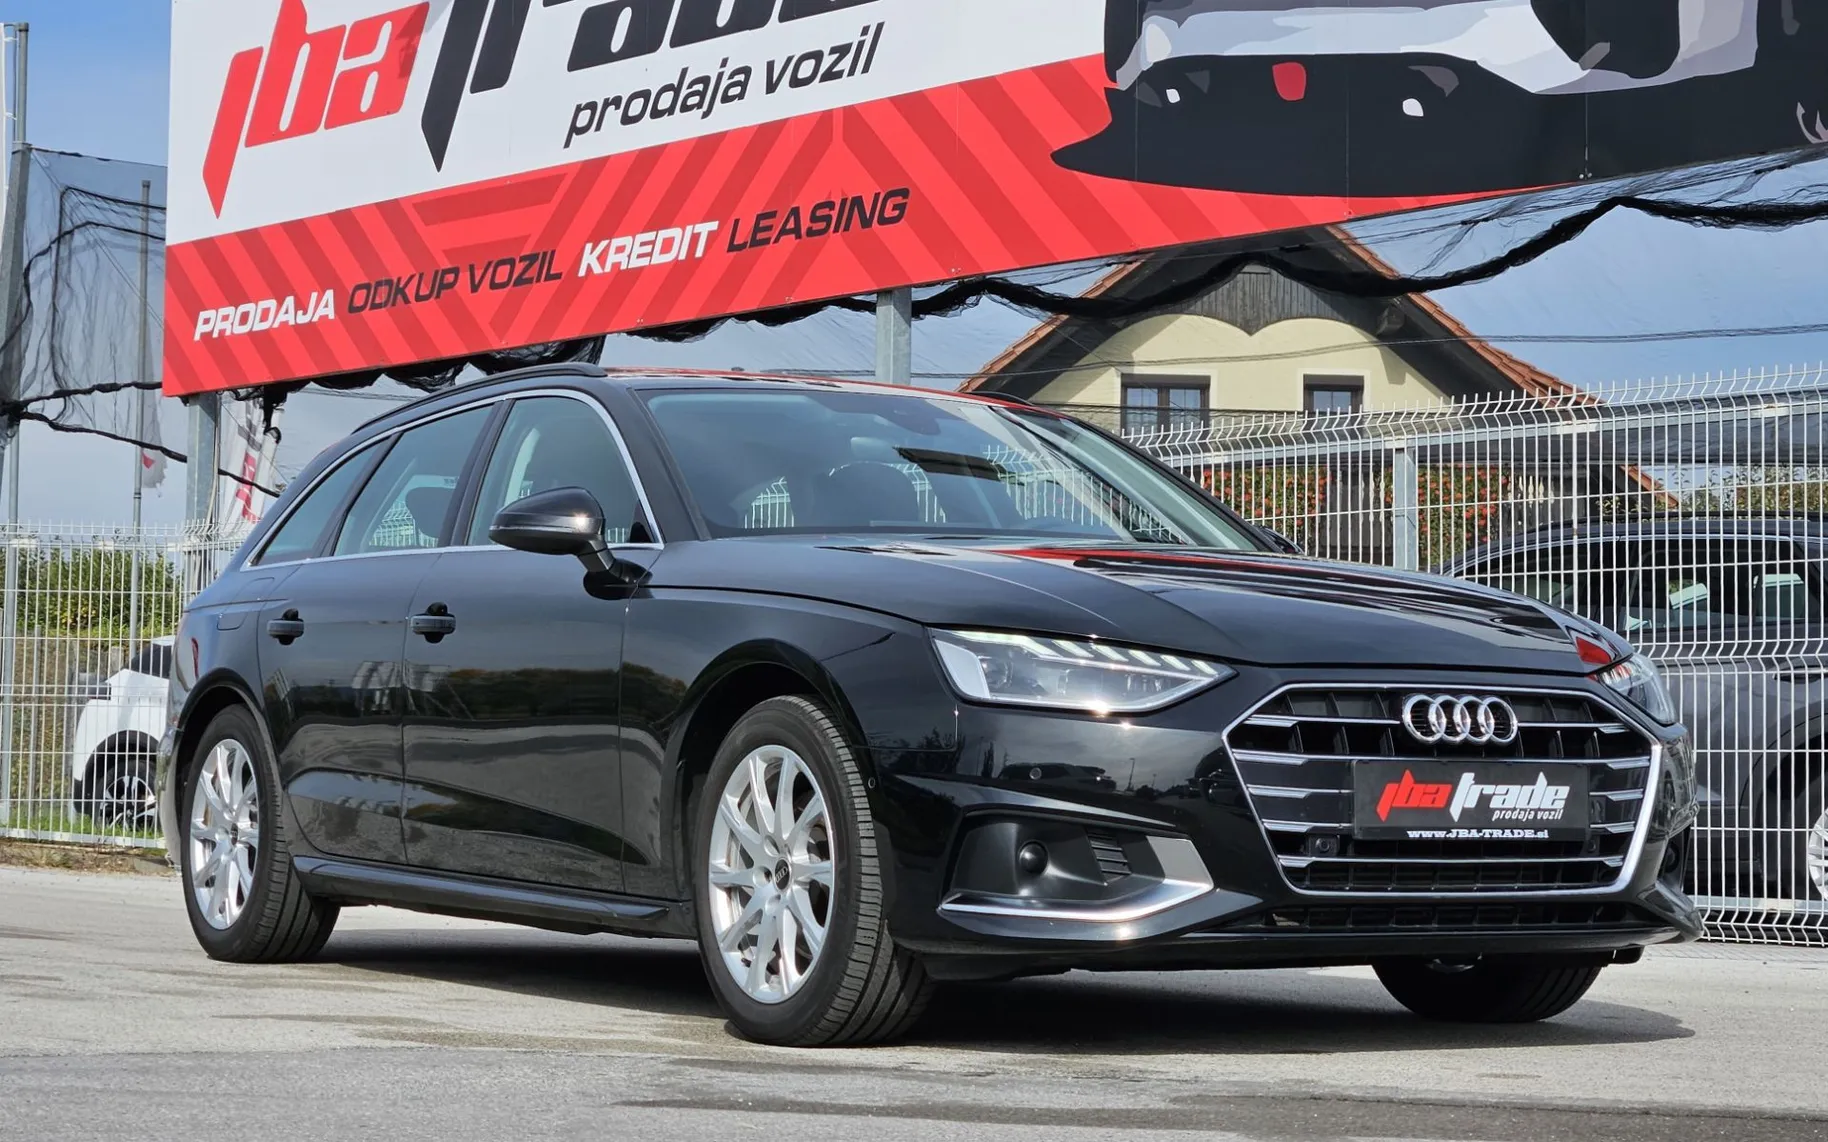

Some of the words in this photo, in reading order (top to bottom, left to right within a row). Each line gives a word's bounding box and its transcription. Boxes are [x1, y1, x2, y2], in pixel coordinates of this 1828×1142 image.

[563, 57, 752, 149] prodaja
[765, 21, 885, 95] vozil
[194, 289, 335, 341] PRODAJA
[347, 266, 459, 314] ODKUP
[468, 249, 563, 294] VOZIL
[577, 220, 719, 277] KREDIT
[726, 187, 910, 253] LEASING
[1406, 828, 1549, 839] www.JBA-TRADE.si
[1492, 808, 1535, 822] prodaja
[1537, 808, 1563, 820] vozil
